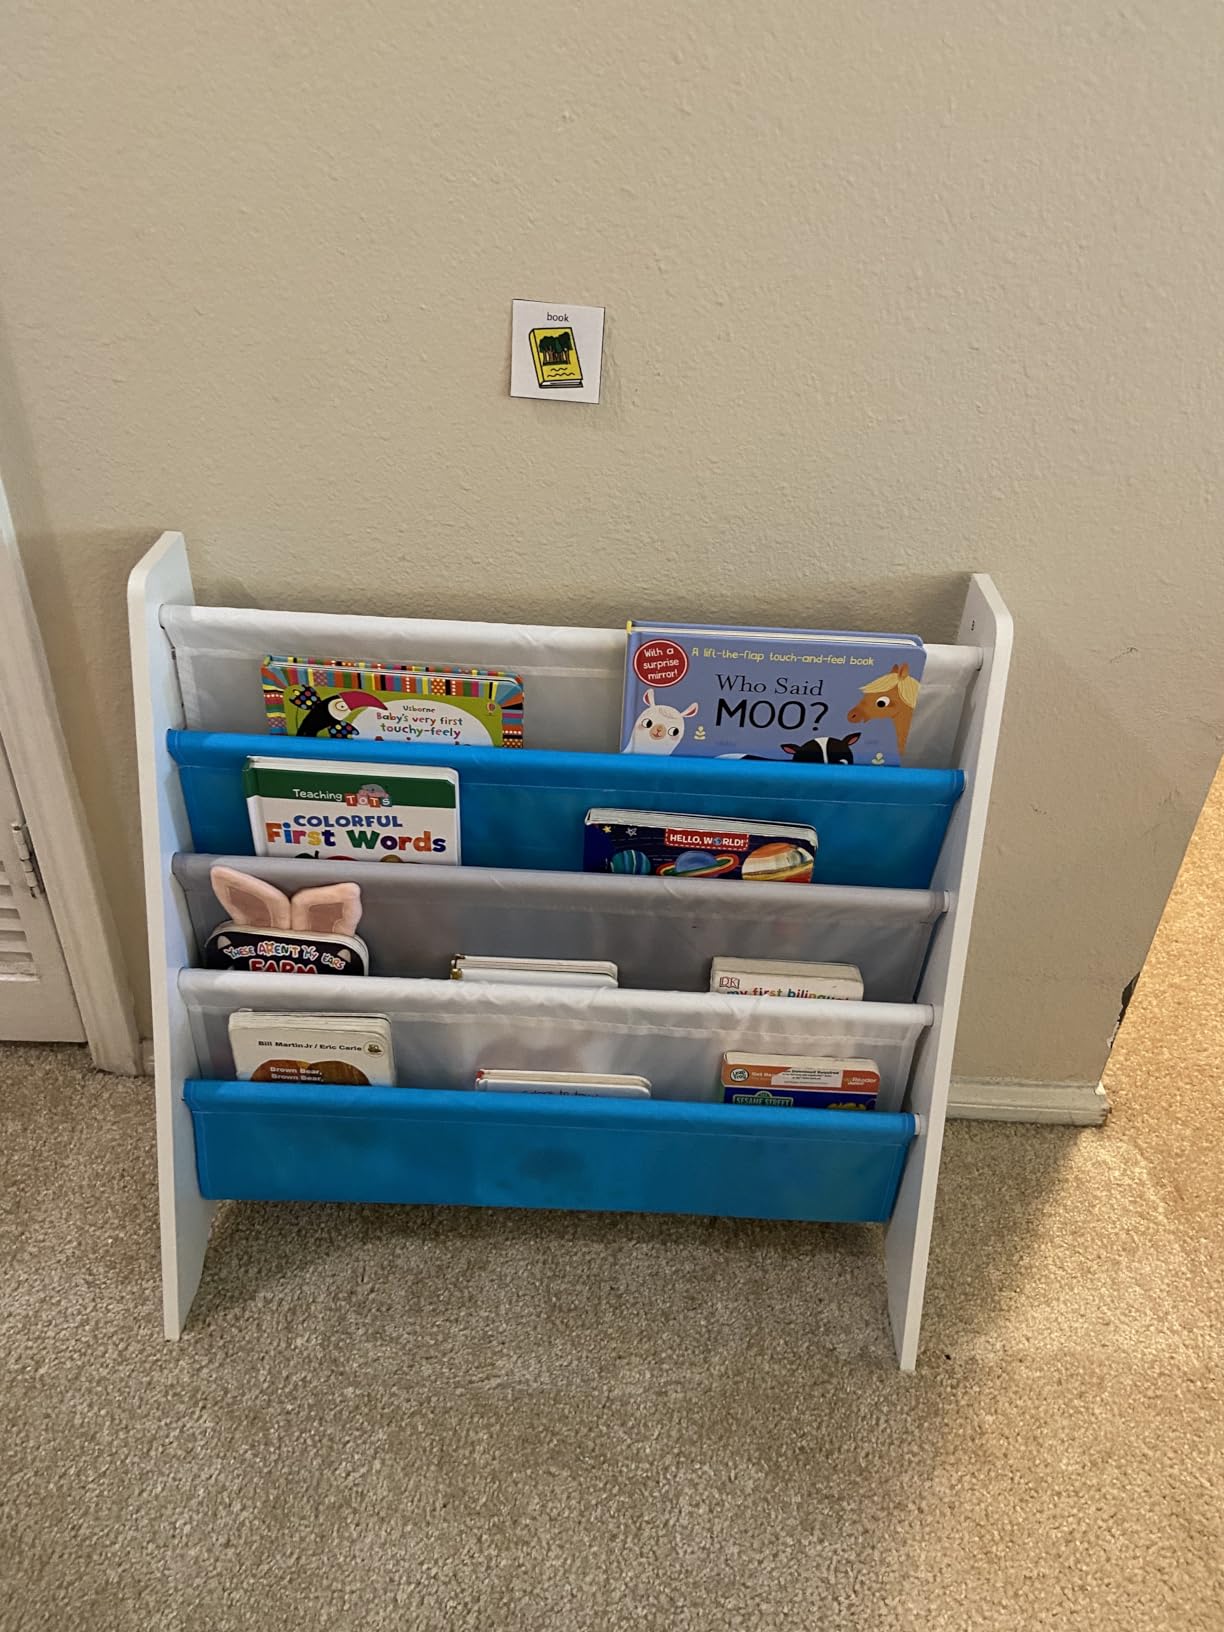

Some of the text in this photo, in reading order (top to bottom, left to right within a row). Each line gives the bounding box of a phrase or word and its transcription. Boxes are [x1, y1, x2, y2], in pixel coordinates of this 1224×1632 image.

[546, 311, 570, 322] book
[643, 647, 675, 658] With a
[691, 647, 875, 667] A lift-the-flap touch-and-feel book
[643, 658, 680, 670] surprise
[647, 668, 679, 680] mirror!
[715, 673, 825, 697] Who Said
[402, 704, 436, 714] Usborne
[715, 697, 830, 732] MOO?
[376, 711, 464, 726] Baby's very first
[379, 722, 462, 740] touchy-feely
[292, 788, 344, 803] Teaching
[293, 814, 403, 828] COLORFUL
[264, 821, 447, 853] First Words
[670, 834, 702, 845] HELLO,
[321, 952, 346, 970] EARS
[720, 976, 740, 989] DK
[269, 1066, 298, 1074] Brown
